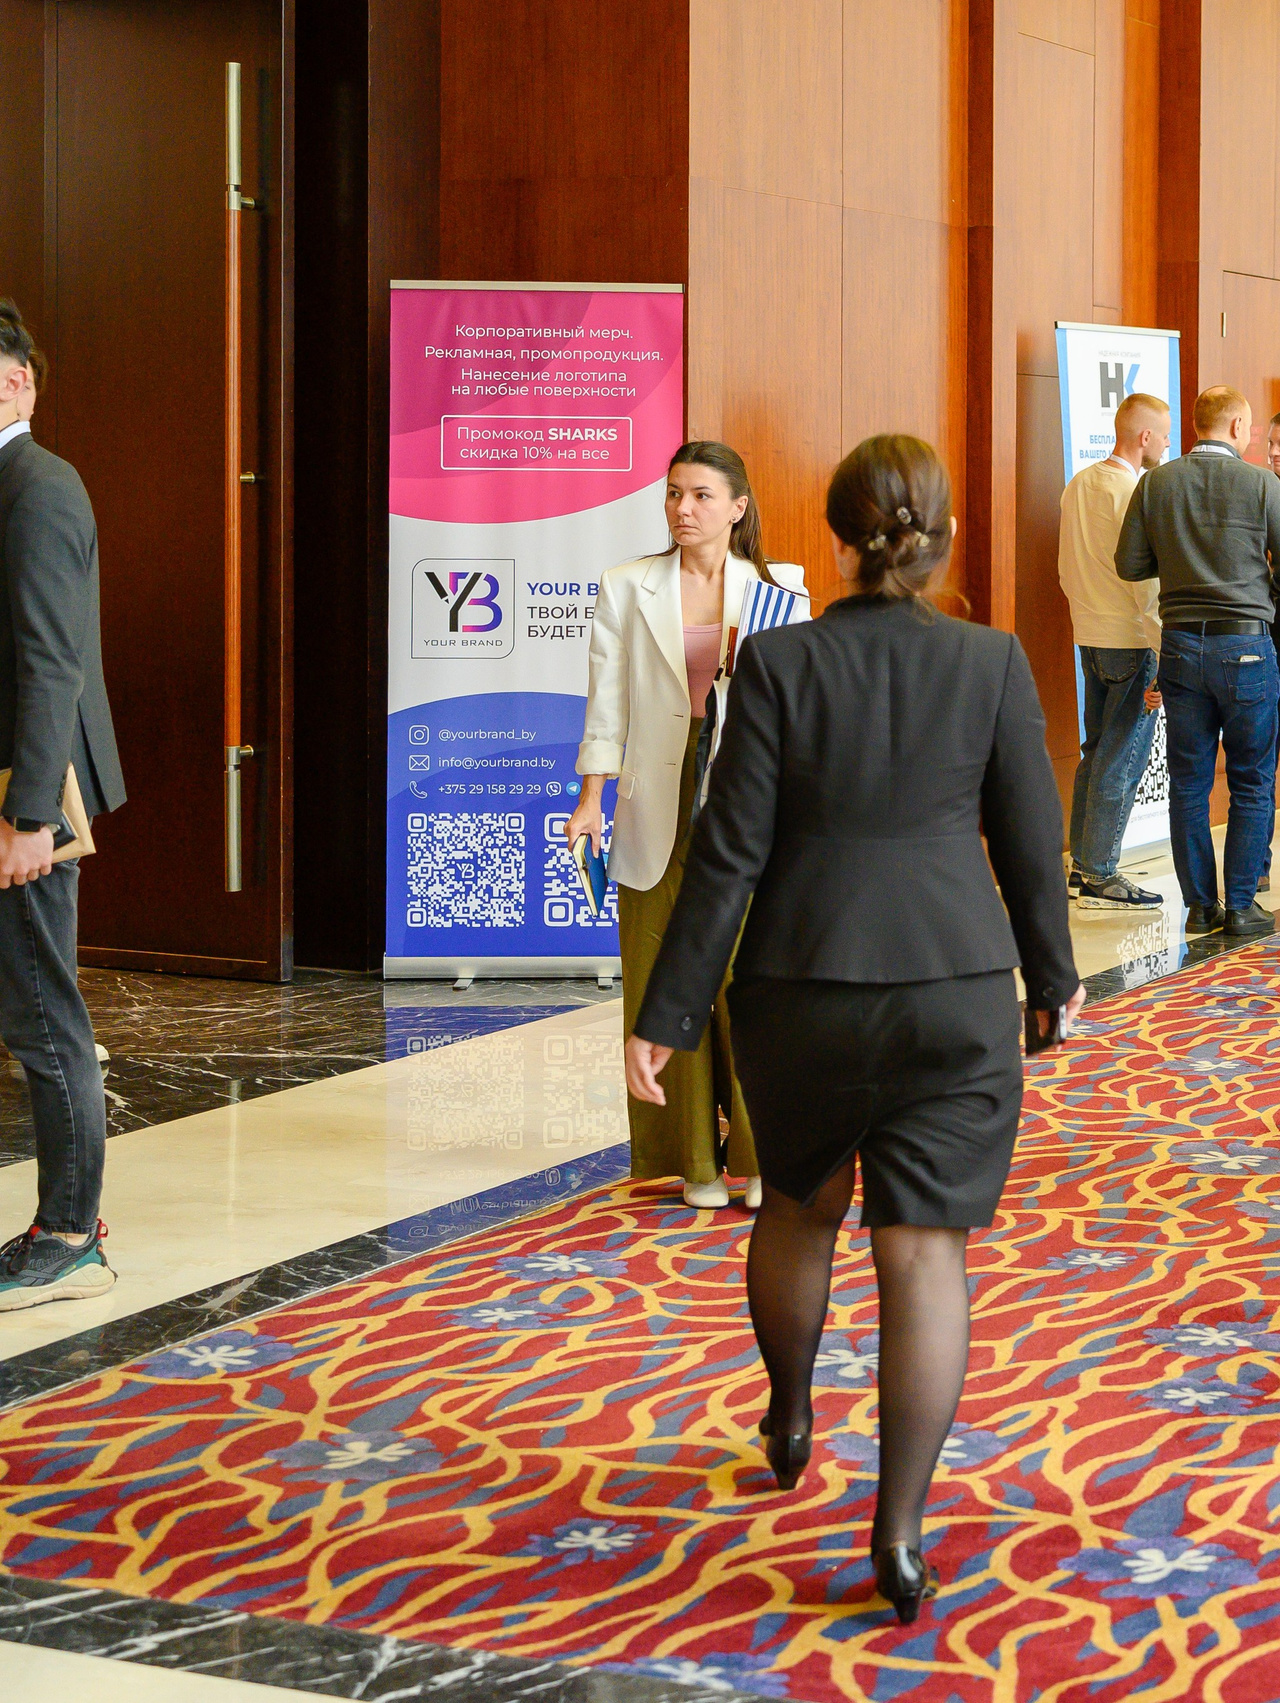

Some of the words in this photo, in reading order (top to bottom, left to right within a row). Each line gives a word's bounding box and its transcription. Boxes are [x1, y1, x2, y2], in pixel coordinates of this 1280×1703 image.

[455, 324, 585, 340] Корпоративный
[589, 328, 633, 342] мерч.
[425, 345, 516, 361] Рекламная,
[520, 348, 664, 364] промопродукция.
[461, 368, 550, 382] Нанесение
[554, 371, 627, 383] логотипа
[451, 386, 470, 396] на
[474, 382, 529, 396] любые
[533, 386, 636, 399] поверхности
[457, 426, 545, 442] Промокод
[548, 427, 618, 442] SHARKS
[1089, 434, 1116, 444] БЕСПЛА
[460, 448, 518, 461] скидка
[522, 446, 553, 460] 10%
[557, 449, 577, 460] на
[581, 449, 610, 461] все
[526, 582, 581, 596] YOUR
[526, 603, 578, 619] ТВОЙ
[527, 625, 587, 641] БУДЕТ
[423, 639, 457, 647] YOUR
[461, 639, 503, 647] BRAND
[438, 728, 537, 742] @yourbrand_by
[438, 756, 556, 770] info@yourbrand.by
[438, 784, 466, 795] +375
[469, 784, 484, 795] 29
[486, 784, 507, 795] 158
[509, 784, 524, 795] 29
[526, 784, 542, 795] 29
